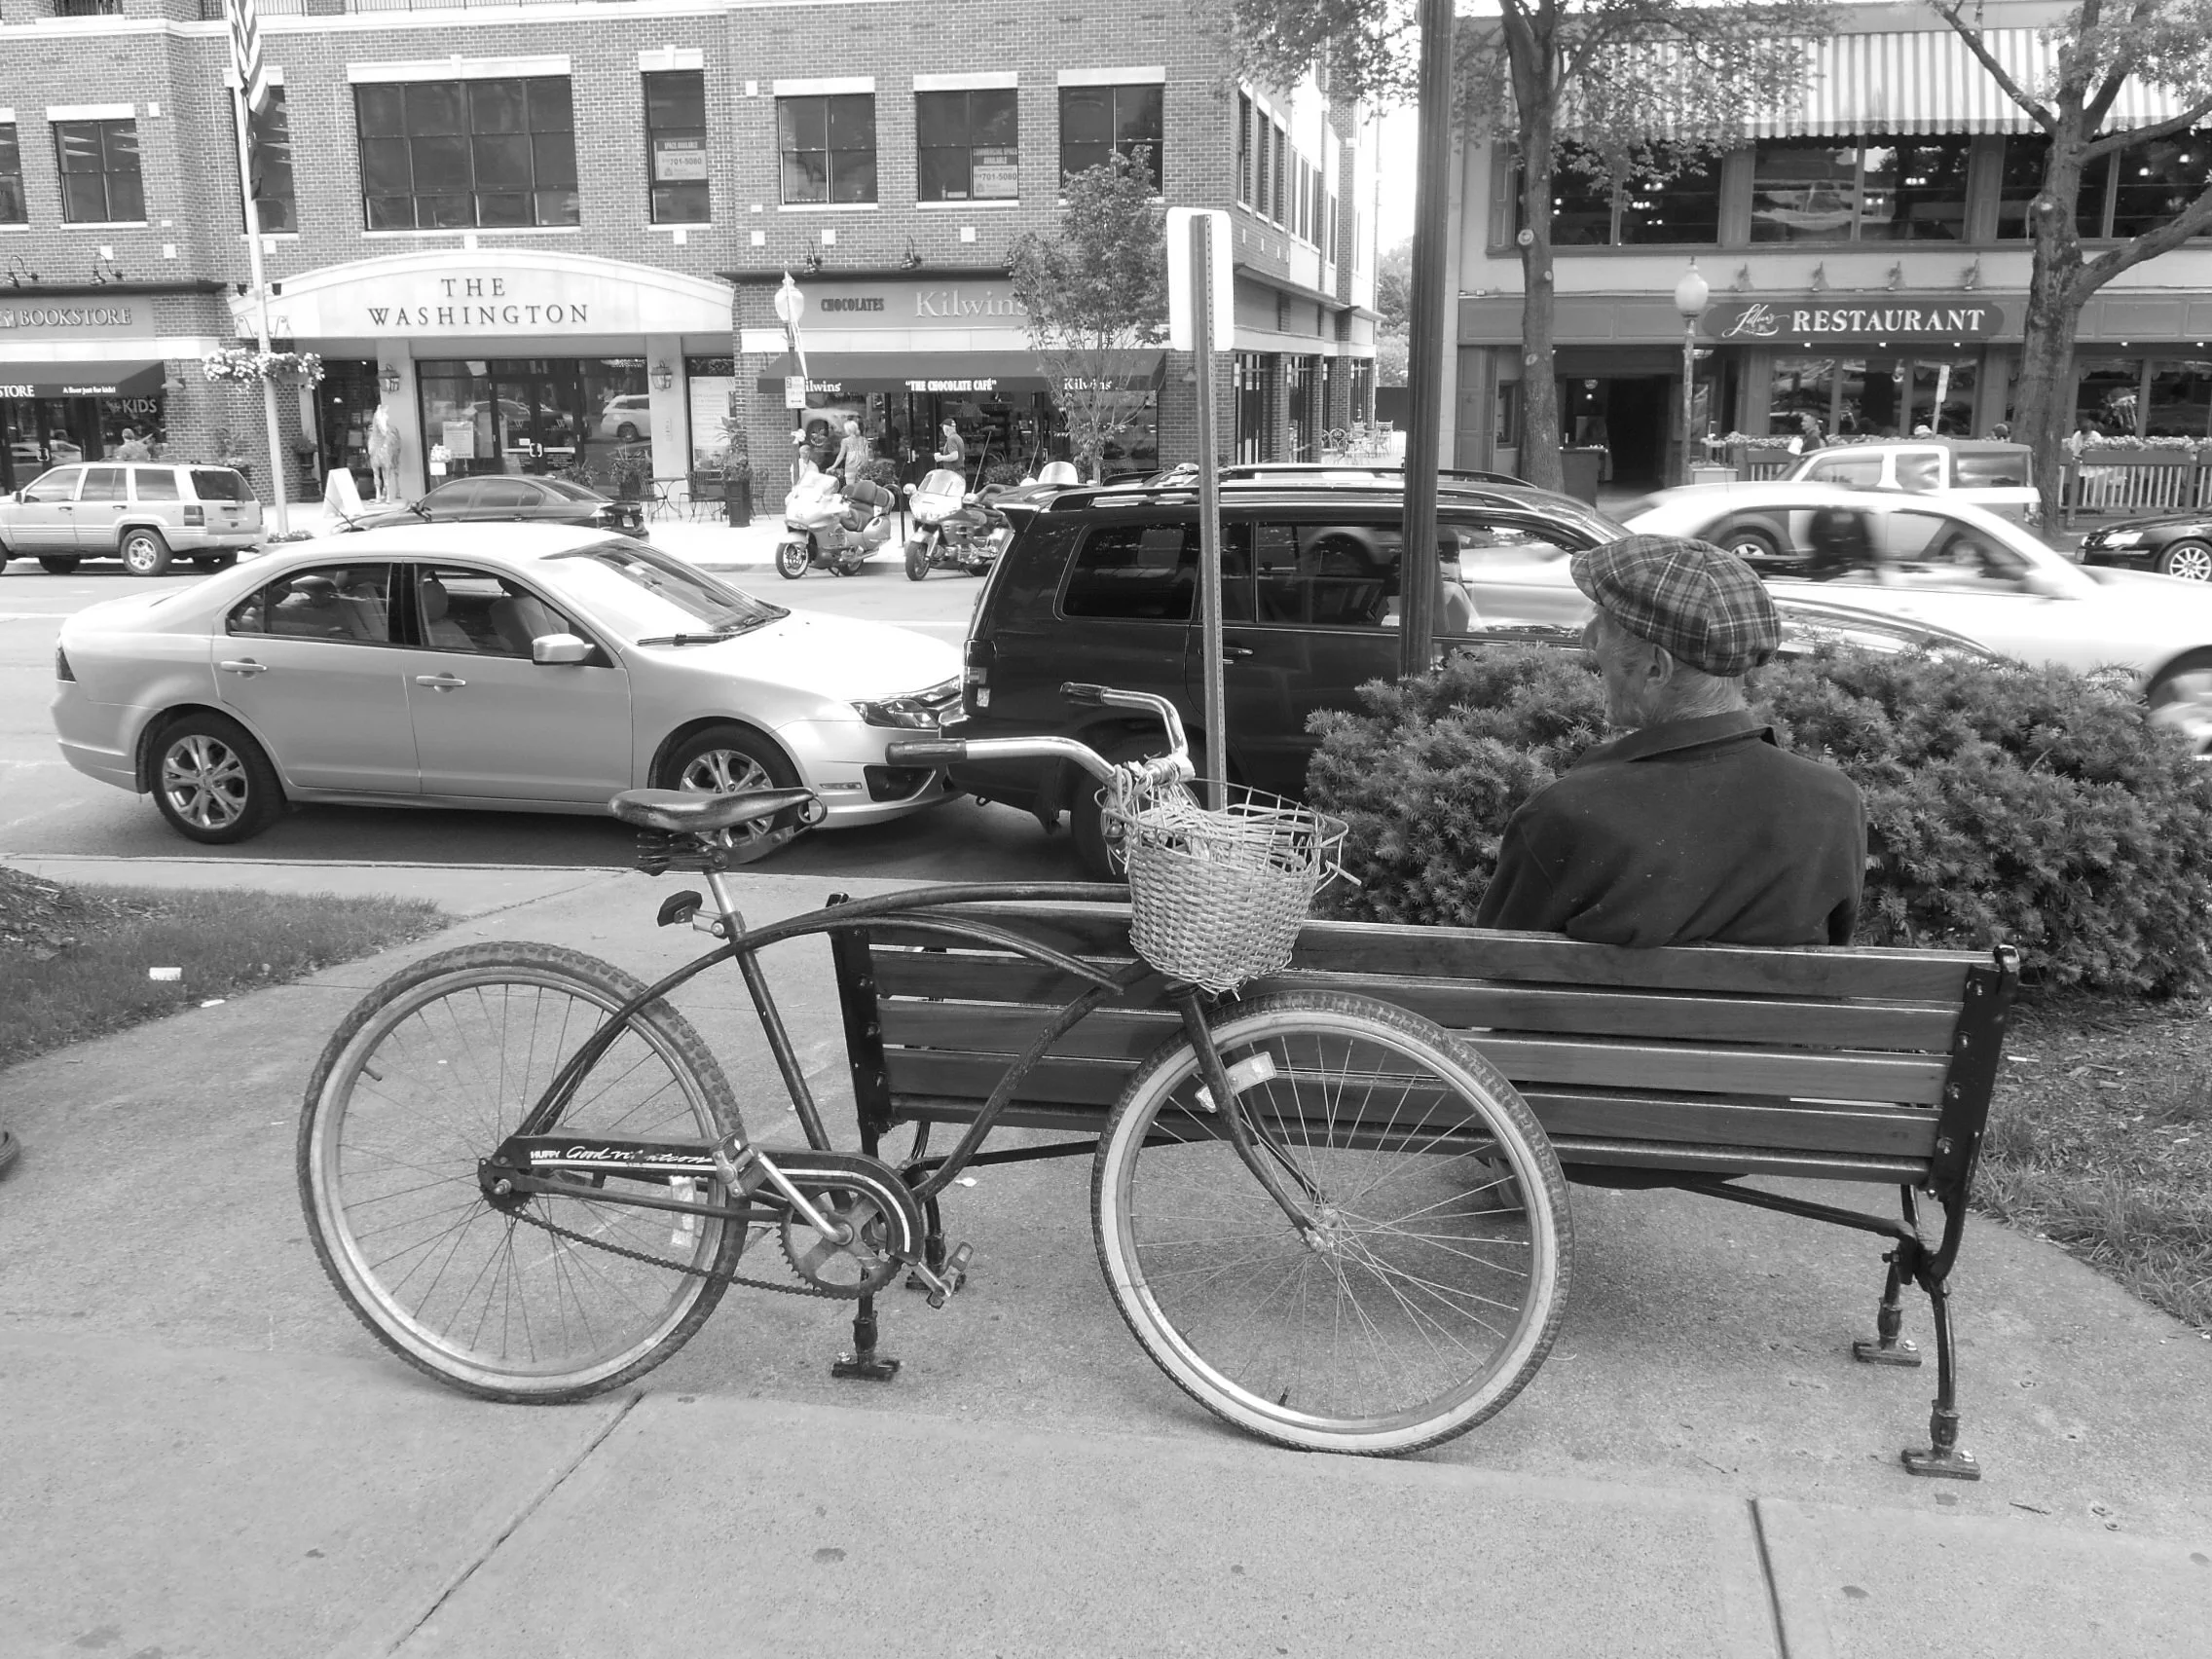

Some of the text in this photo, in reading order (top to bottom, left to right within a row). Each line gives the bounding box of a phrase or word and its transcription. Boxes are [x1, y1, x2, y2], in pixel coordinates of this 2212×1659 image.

[441, 277, 505, 297] THE
[821, 297, 885, 312] CHOCOLATES
[19, 308, 132, 327] BOOKSTORE
[368, 304, 588, 326] WASHINGTON
[1791, 310, 1985, 332] RESTAURANT
[805, 379, 842, 391] ilwins
[927, 380, 972, 391] CHOCOLATE
[123, 399, 157, 414] KIDS
[530, 1150, 561, 1160] HUFFY
[566, 1145, 611, 1160] Good
